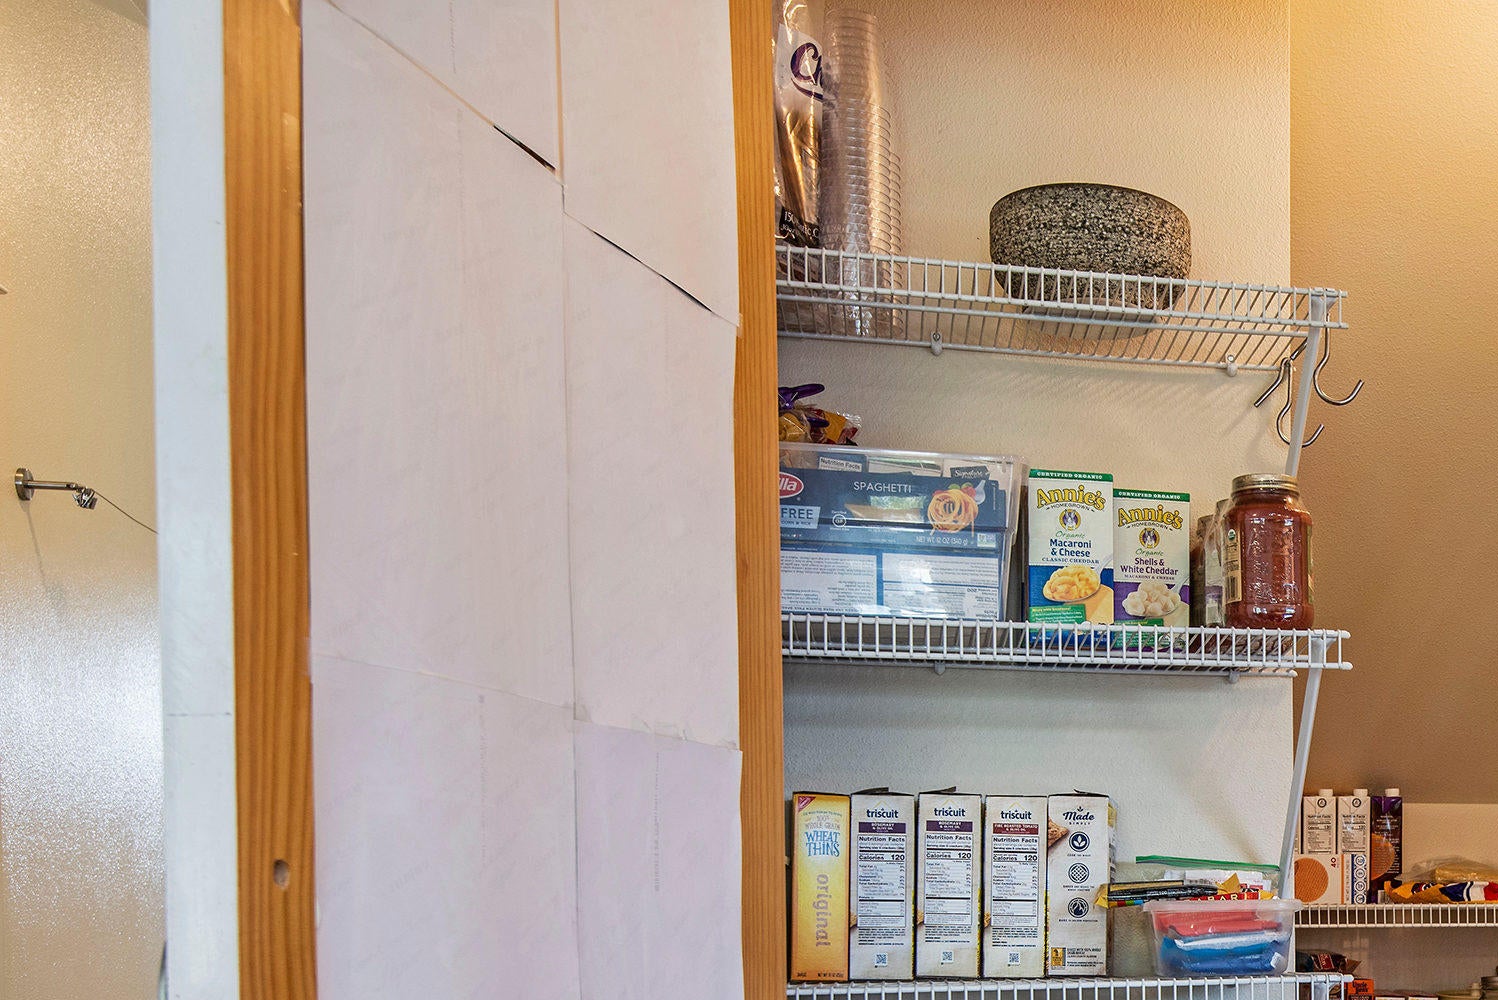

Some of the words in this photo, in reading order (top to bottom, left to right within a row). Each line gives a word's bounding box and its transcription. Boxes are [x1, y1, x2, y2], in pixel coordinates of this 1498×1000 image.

[853, 481, 912, 494] SPAGHETTI
[1036, 484, 1107, 511] Annie's
[780, 508, 814, 520] FREE
[1117, 503, 1184, 530] Annie's
[1055, 530, 1086, 540] Organic
[1049, 538, 1092, 549] Macaroni
[1050, 548, 1057, 557] &
[1058, 548, 1091, 558] Cheese
[1134, 548, 1164, 557] Organic
[1134, 557, 1158, 566] Shells
[1158, 559, 1165, 567] &
[1120, 565, 1144, 574] White
[1145, 566, 1179, 576] Cheddar
[866, 808, 899, 818] triscuit
[933, 807, 966, 817] triscuit
[1000, 810, 1033, 820] triscuit
[1062, 811, 1095, 821] Made
[804, 830, 841, 842] WHEAT
[813, 873, 832, 947] original
